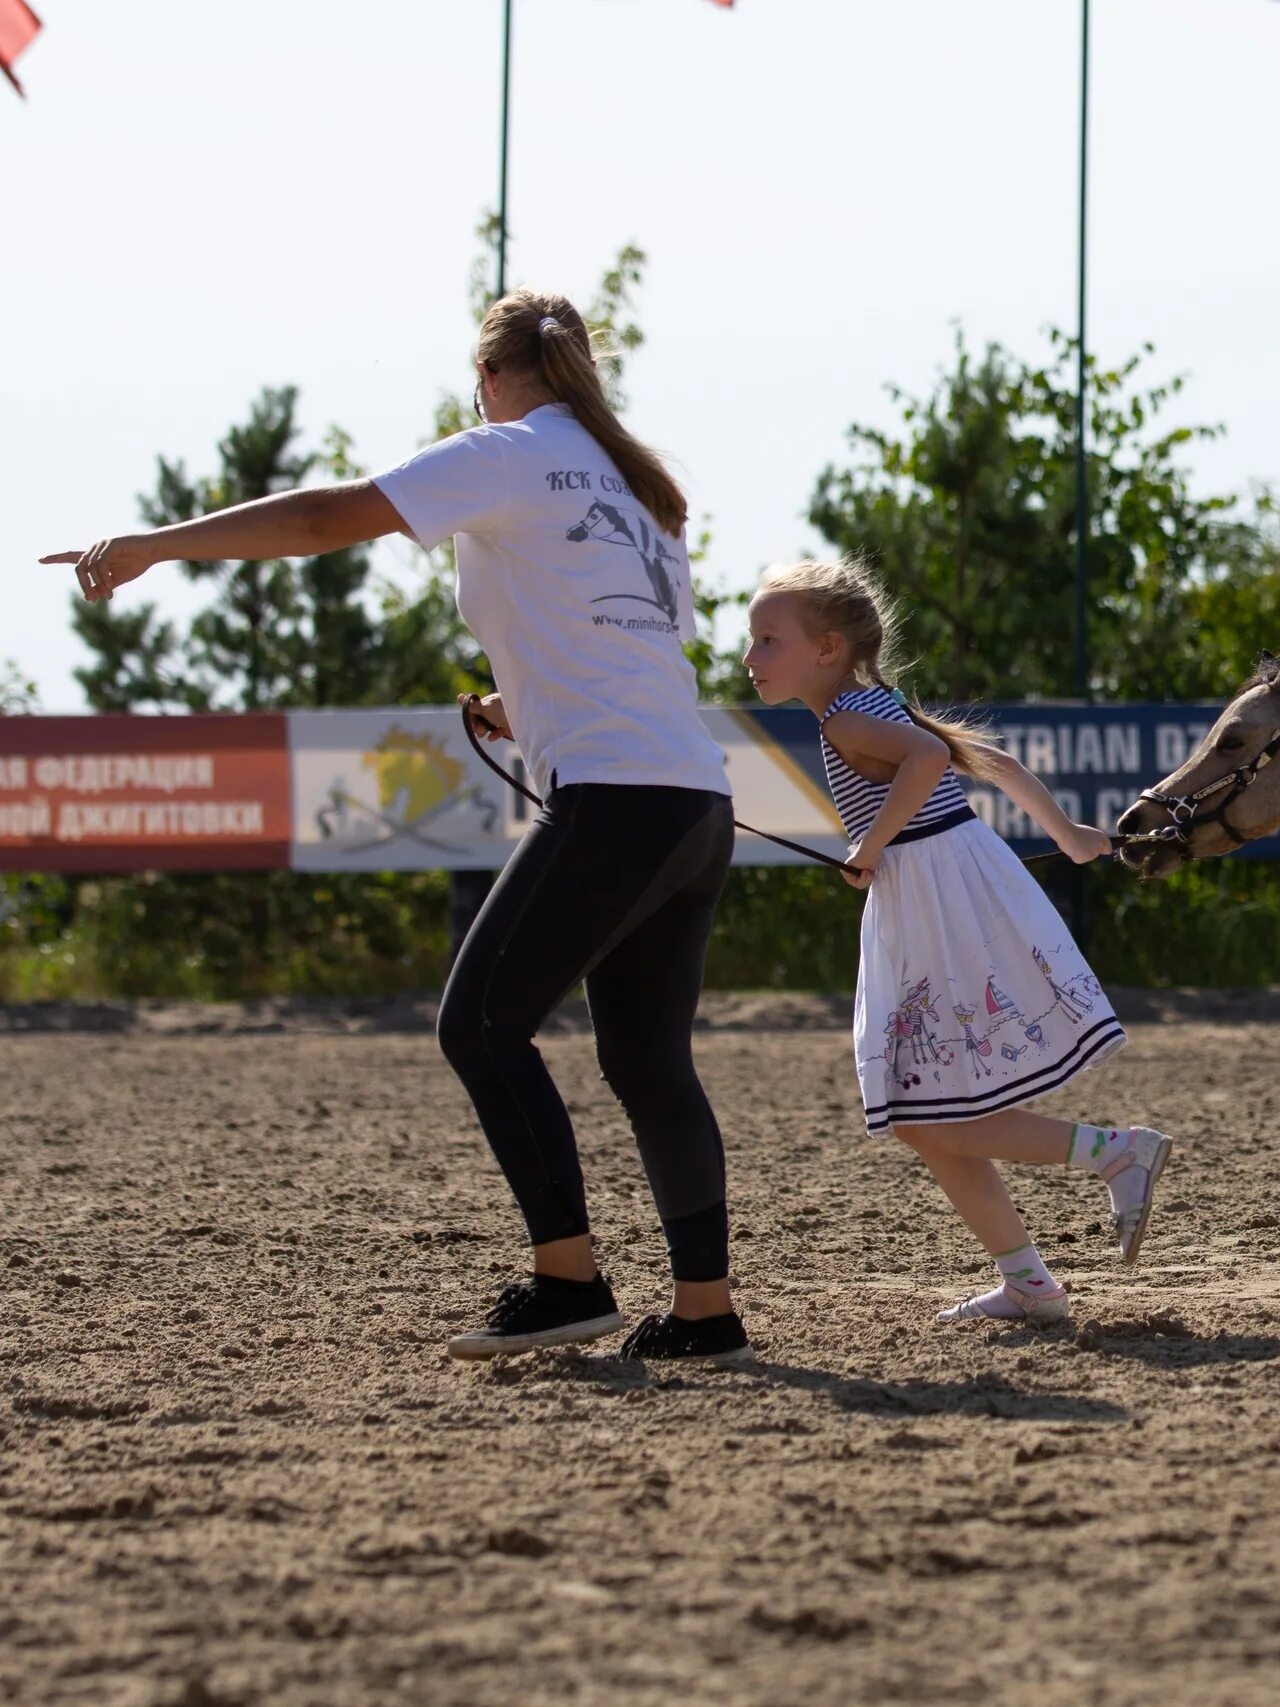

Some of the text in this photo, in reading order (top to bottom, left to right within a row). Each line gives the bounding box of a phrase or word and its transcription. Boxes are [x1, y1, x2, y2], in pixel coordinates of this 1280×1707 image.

[985, 724, 1141, 773] TRIAN
[35, 755, 213, 793] ФЕДЕРАЦИЯ
[57, 801, 262, 842] ДЖИГИТОВКИ
